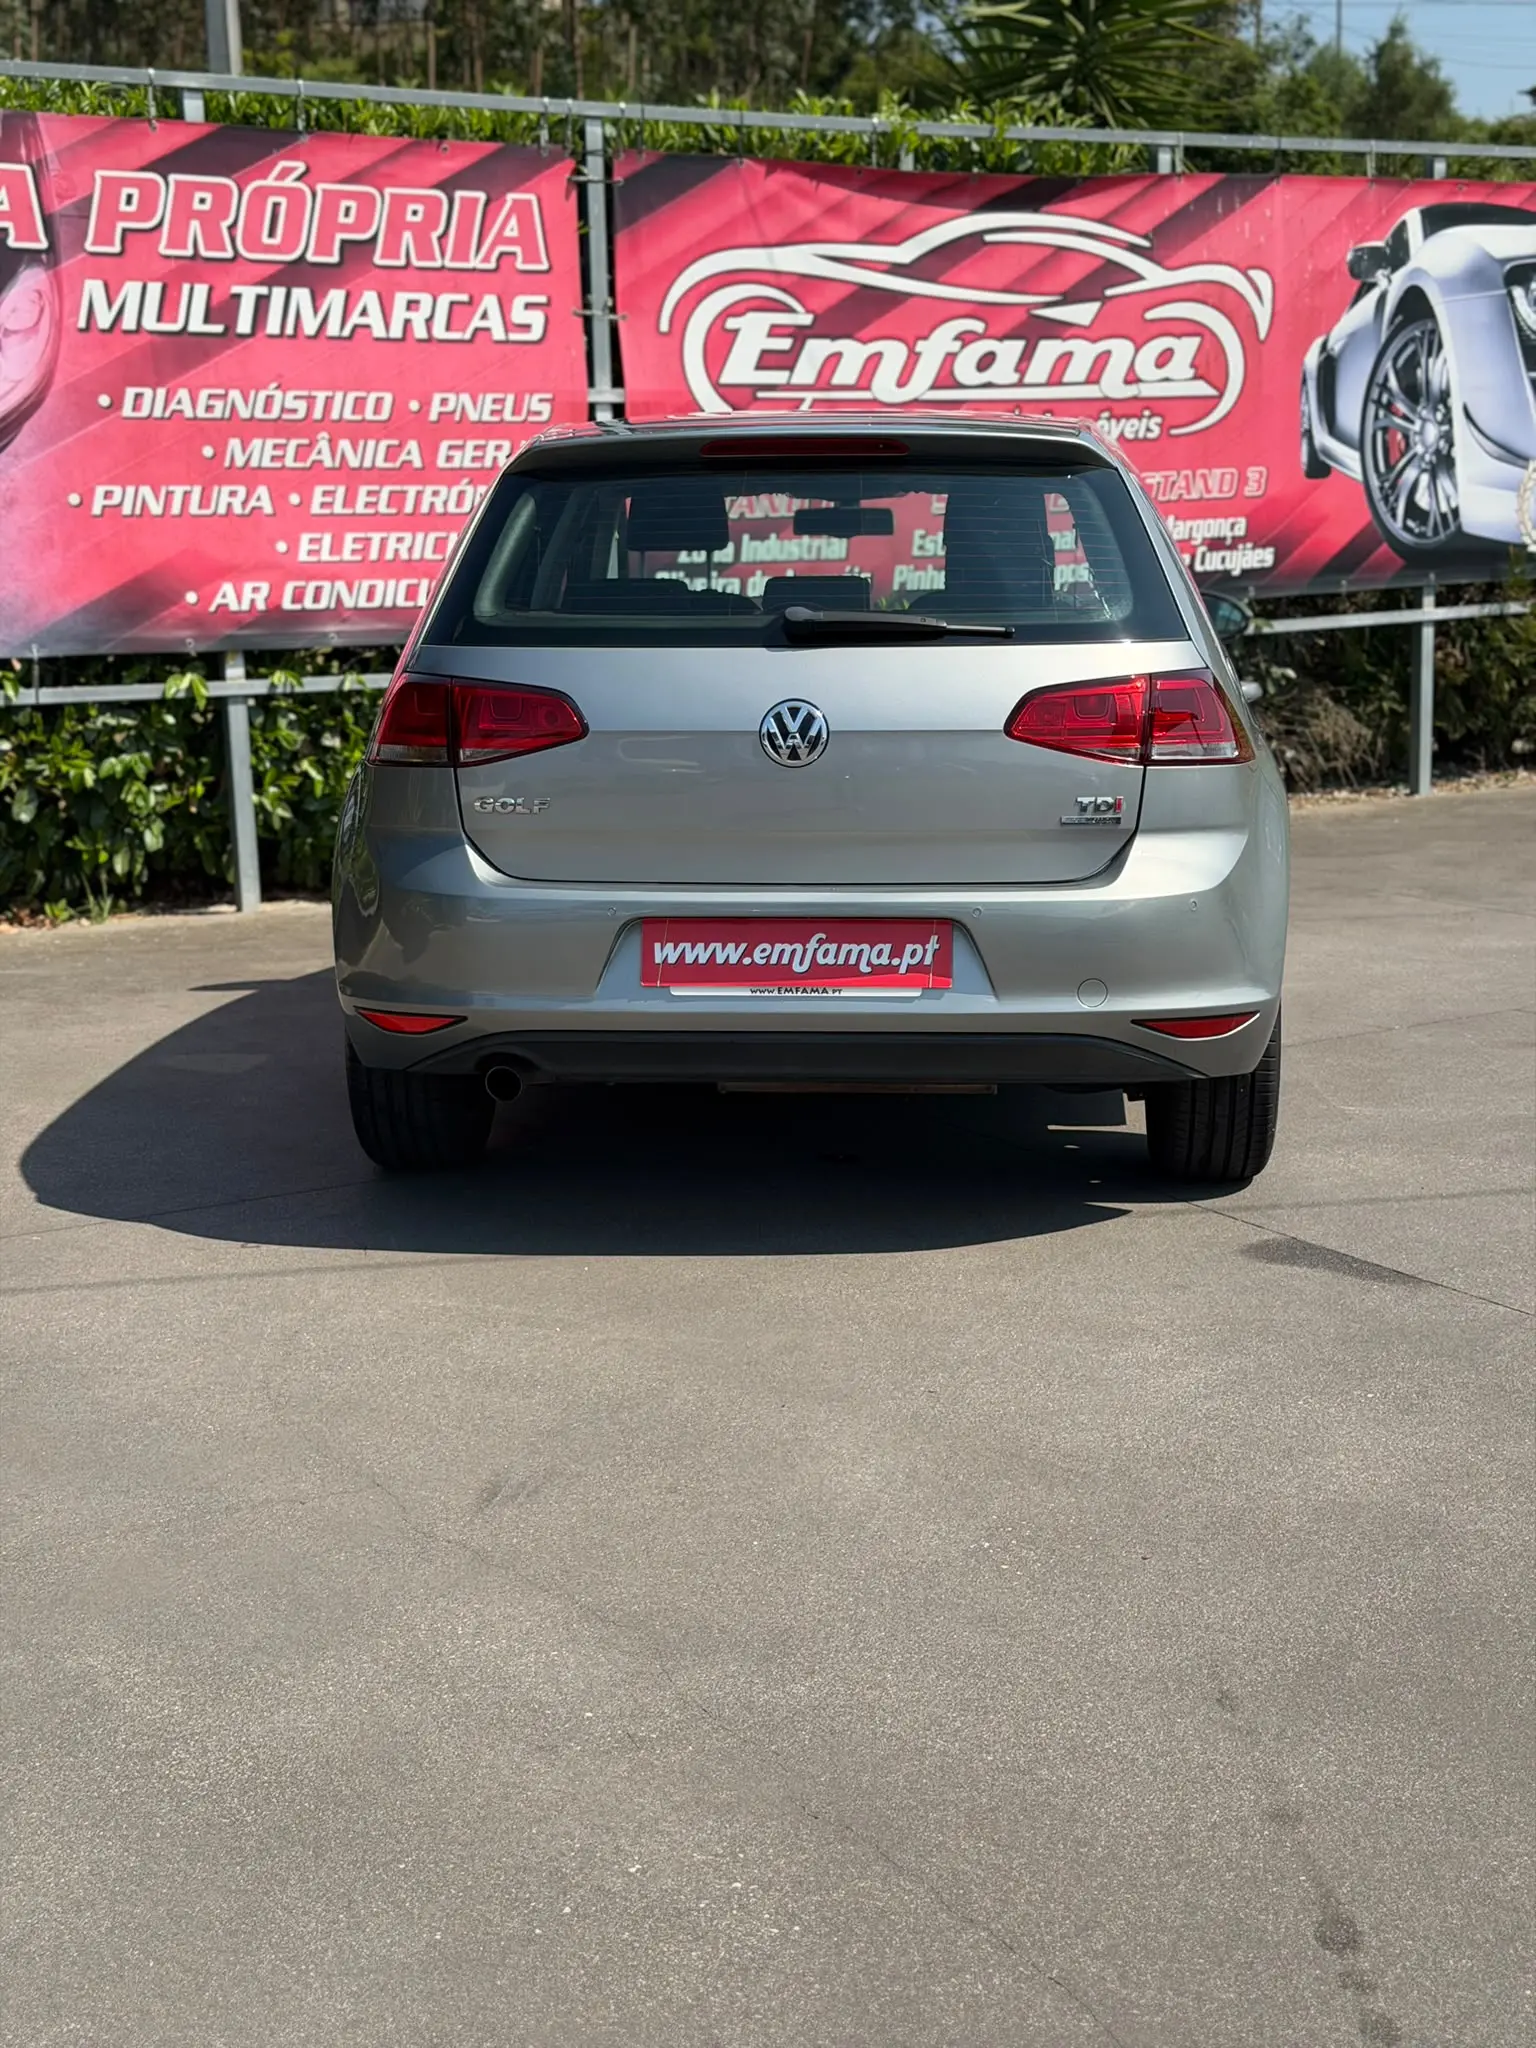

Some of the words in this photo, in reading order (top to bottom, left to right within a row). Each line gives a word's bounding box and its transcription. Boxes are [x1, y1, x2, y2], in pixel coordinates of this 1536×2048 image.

[84, 159, 550, 272] PRÓPRIA
[77, 279, 549, 342] MULTIMARCAS
[718, 311, 1202, 402] Emfama
[121, 384, 393, 422] DIAGNÓSTICO
[428, 392, 553, 423] PNEUS
[224, 433, 424, 469] MECÂNICA
[437, 439, 526, 469] GER
[1243, 466, 1268, 497] 3
[91, 485, 274, 516] PINTURA
[740, 533, 848, 562] Industrial
[1193, 541, 1276, 577] Cucujães
[208, 581, 269, 612] AR
[281, 579, 435, 609] CONDICI
[473, 796, 551, 815] GOLF
[653, 932, 940, 974] www.emfama.pt
